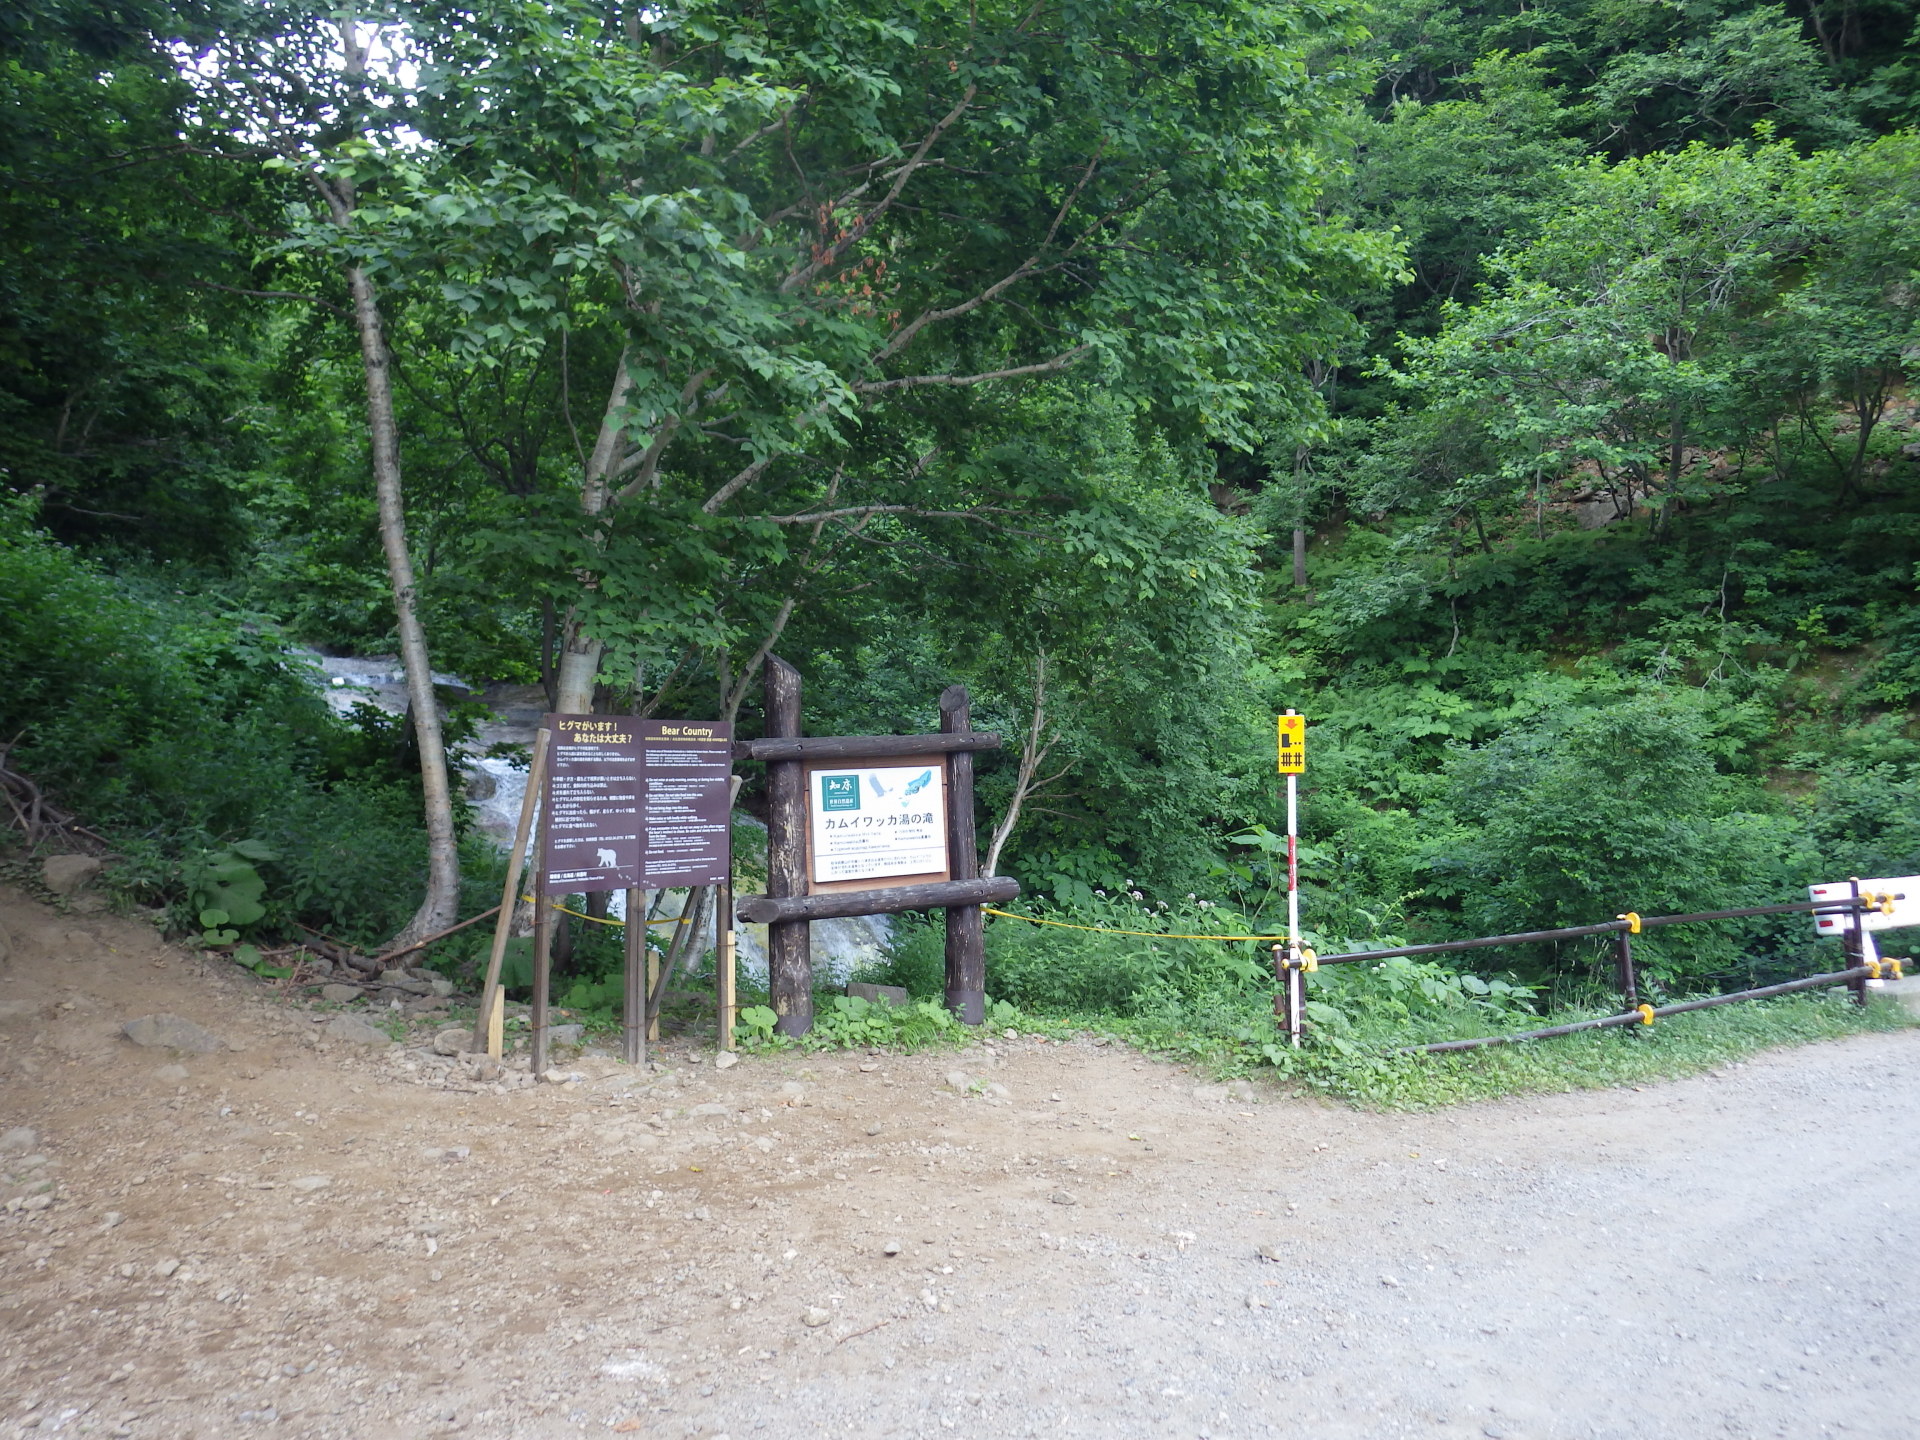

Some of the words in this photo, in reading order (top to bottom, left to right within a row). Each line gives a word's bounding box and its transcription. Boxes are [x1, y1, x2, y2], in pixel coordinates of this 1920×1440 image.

[661, 725, 680, 735] Bear
[682, 726, 713, 737] Country
[829, 778, 852, 791] 知床
[825, 812, 934, 830] カムイワッカ湯の滝
